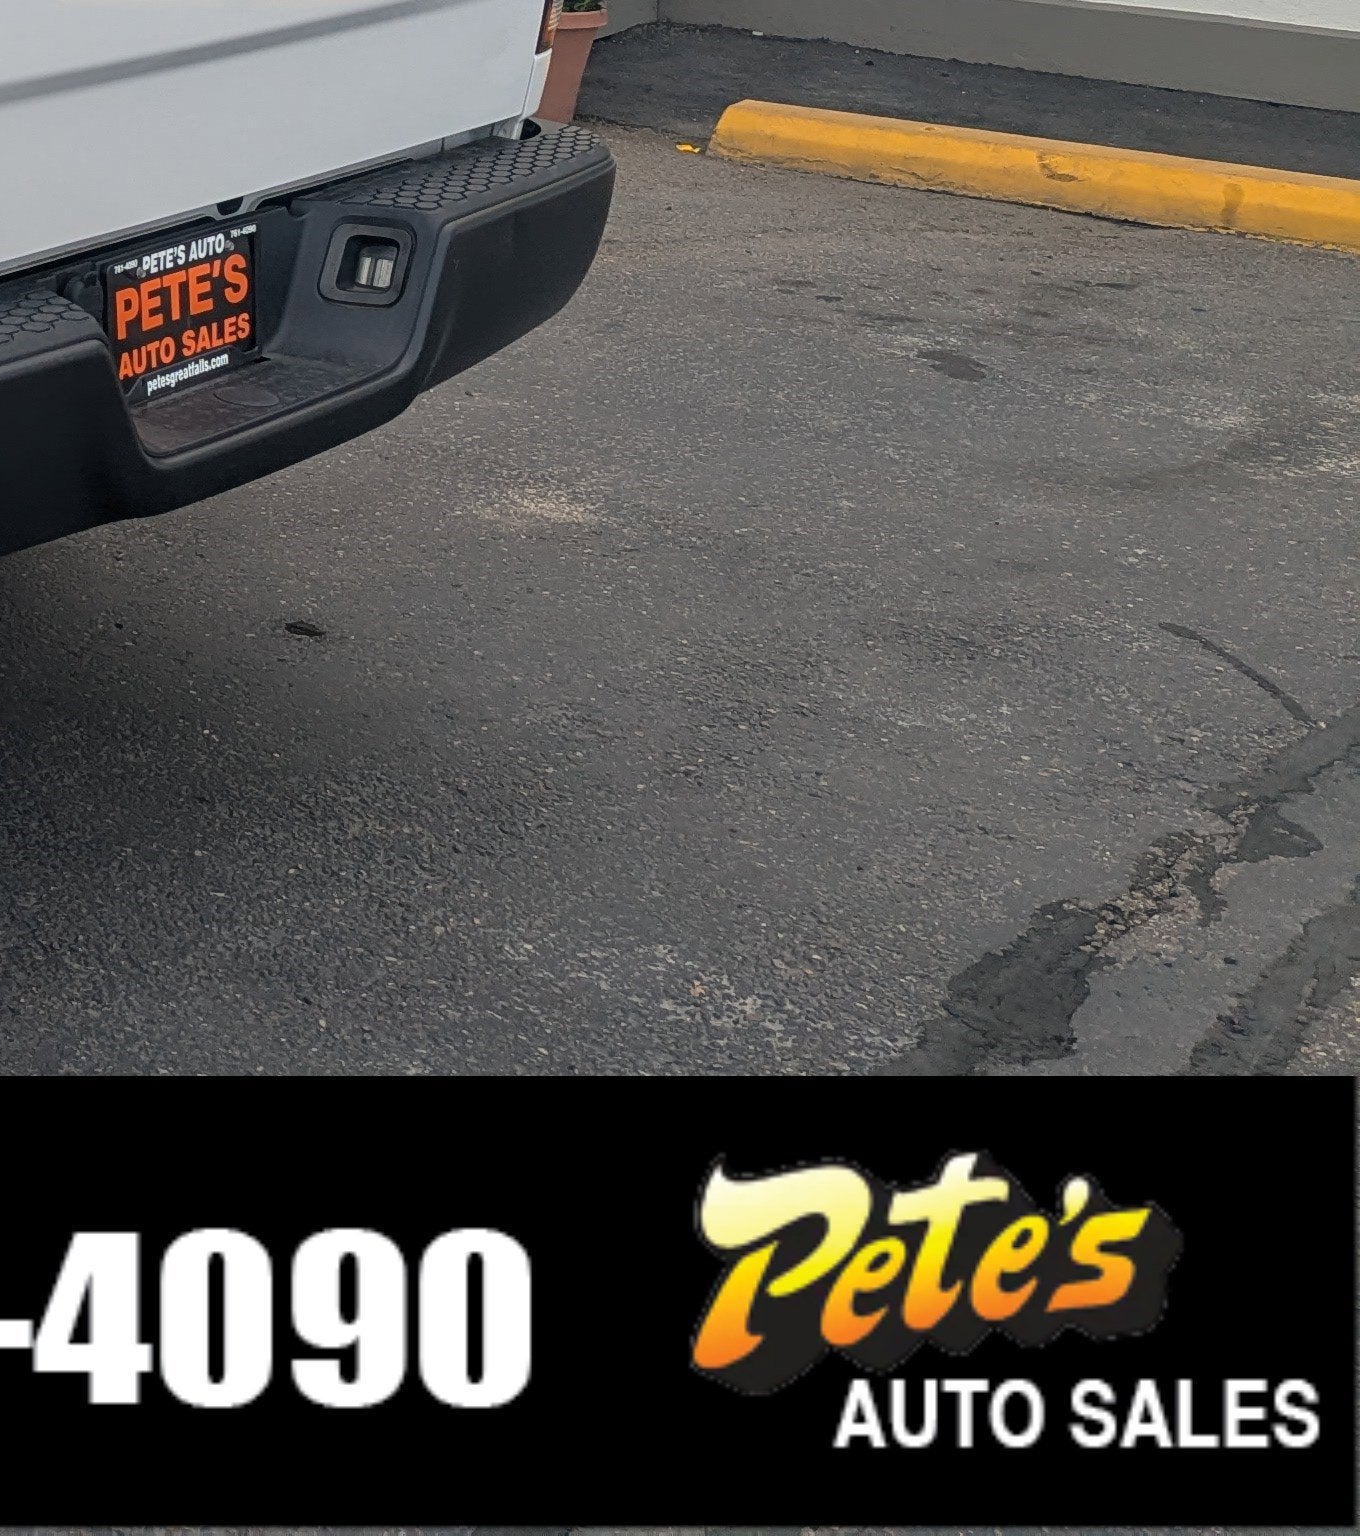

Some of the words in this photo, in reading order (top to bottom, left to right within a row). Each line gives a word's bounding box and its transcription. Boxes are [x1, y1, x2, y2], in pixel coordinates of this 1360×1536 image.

[142, 244, 186, 274] PETE'S
[188, 232, 225, 262] AUTO
[115, 253, 249, 341] PETE'S
[118, 336, 176, 381] AUTO
[181, 312, 251, 357] SALES
[147, 353, 229, 396] petesgreatfalls.com
